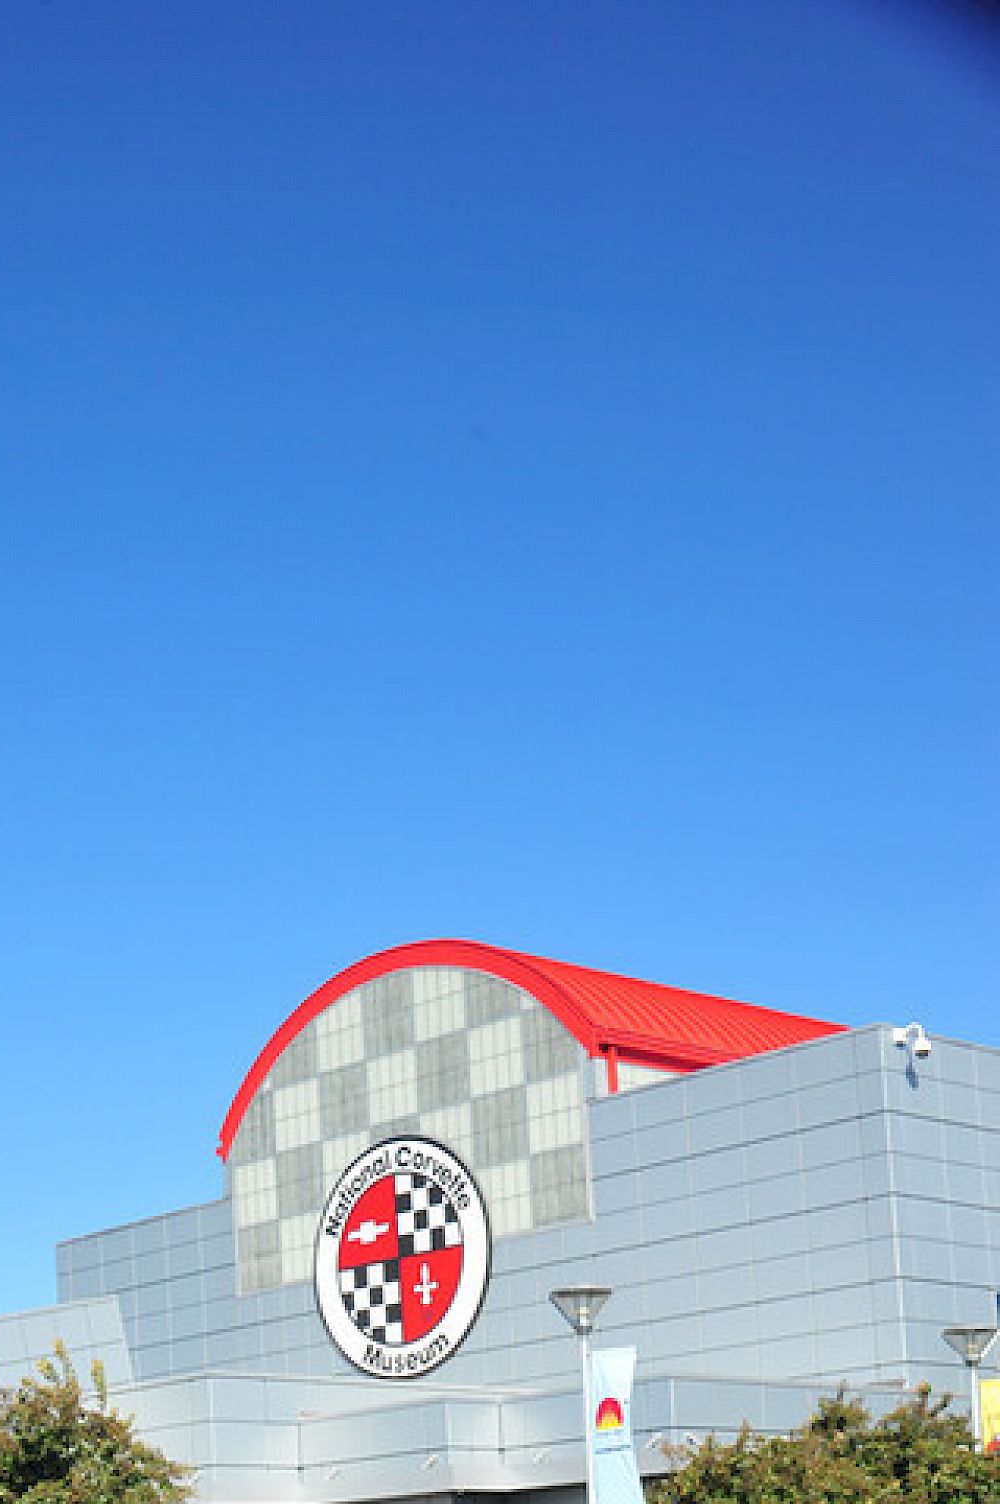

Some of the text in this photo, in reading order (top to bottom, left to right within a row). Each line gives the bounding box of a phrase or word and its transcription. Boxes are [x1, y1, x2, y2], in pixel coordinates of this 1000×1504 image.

[325, 1146, 470, 1236] National Corvette
[363, 1334, 449, 1373] Museum
